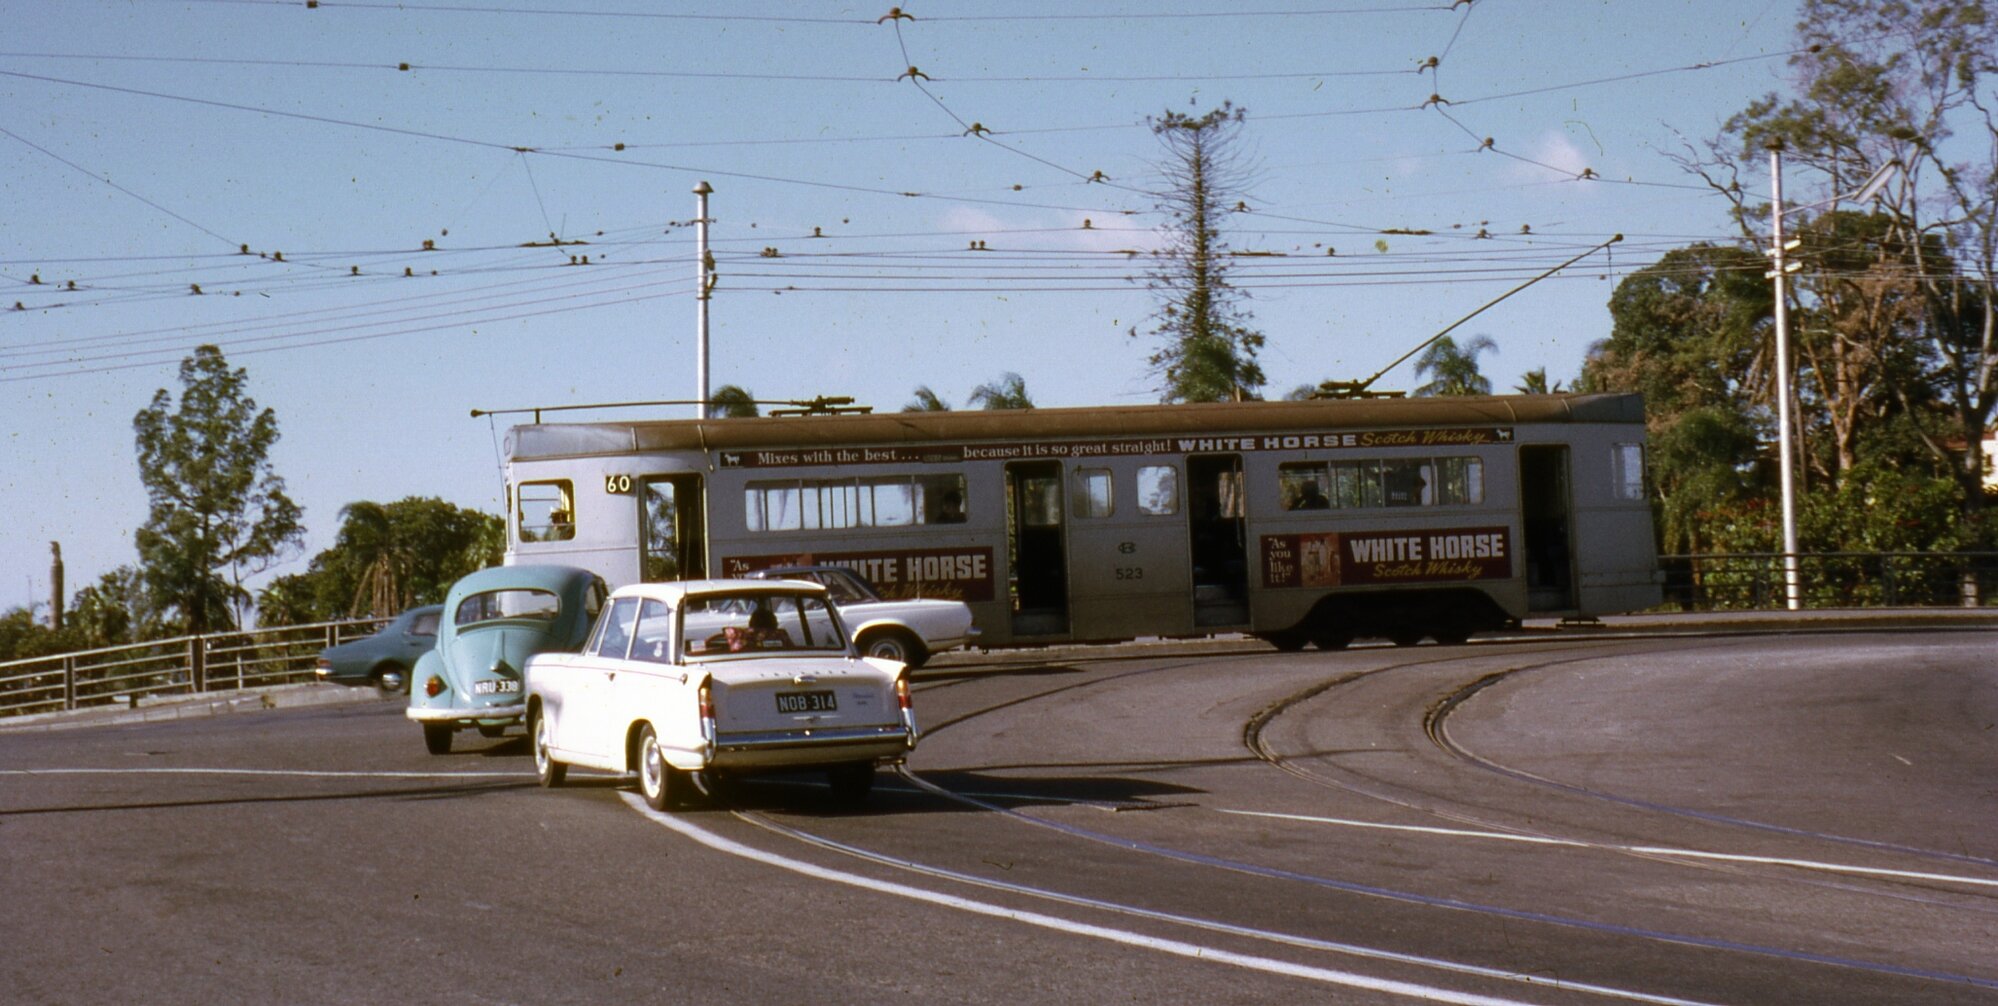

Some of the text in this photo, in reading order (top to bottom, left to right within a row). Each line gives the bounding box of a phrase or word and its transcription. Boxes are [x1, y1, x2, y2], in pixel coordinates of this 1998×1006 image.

[758, 452, 798, 465] Mixes
[803, 451, 832, 463] with
[836, 449, 860, 462] the
[963, 446, 1020, 458] because
[1023, 444, 1034, 456] it
[1035, 444, 1048, 455] is
[1051, 444, 1068, 455] so
[1071, 443, 1106, 457] great
[1111, 440, 1171, 455] straight!
[1178, 438, 1255, 451] WHITE
[1264, 435, 1356, 449] HORSE
[1361, 431, 1418, 447] Scotch
[1421, 429, 1490, 446] Whisky
[607, 475, 630, 493] 60
[1269, 550, 1291, 561] you
[1350, 534, 1504, 563] WHITE HORSE
[906, 554, 987, 582] HORSE
[1116, 567, 1143, 580] 523
[1373, 560, 1483, 579] Scotch Whisky
